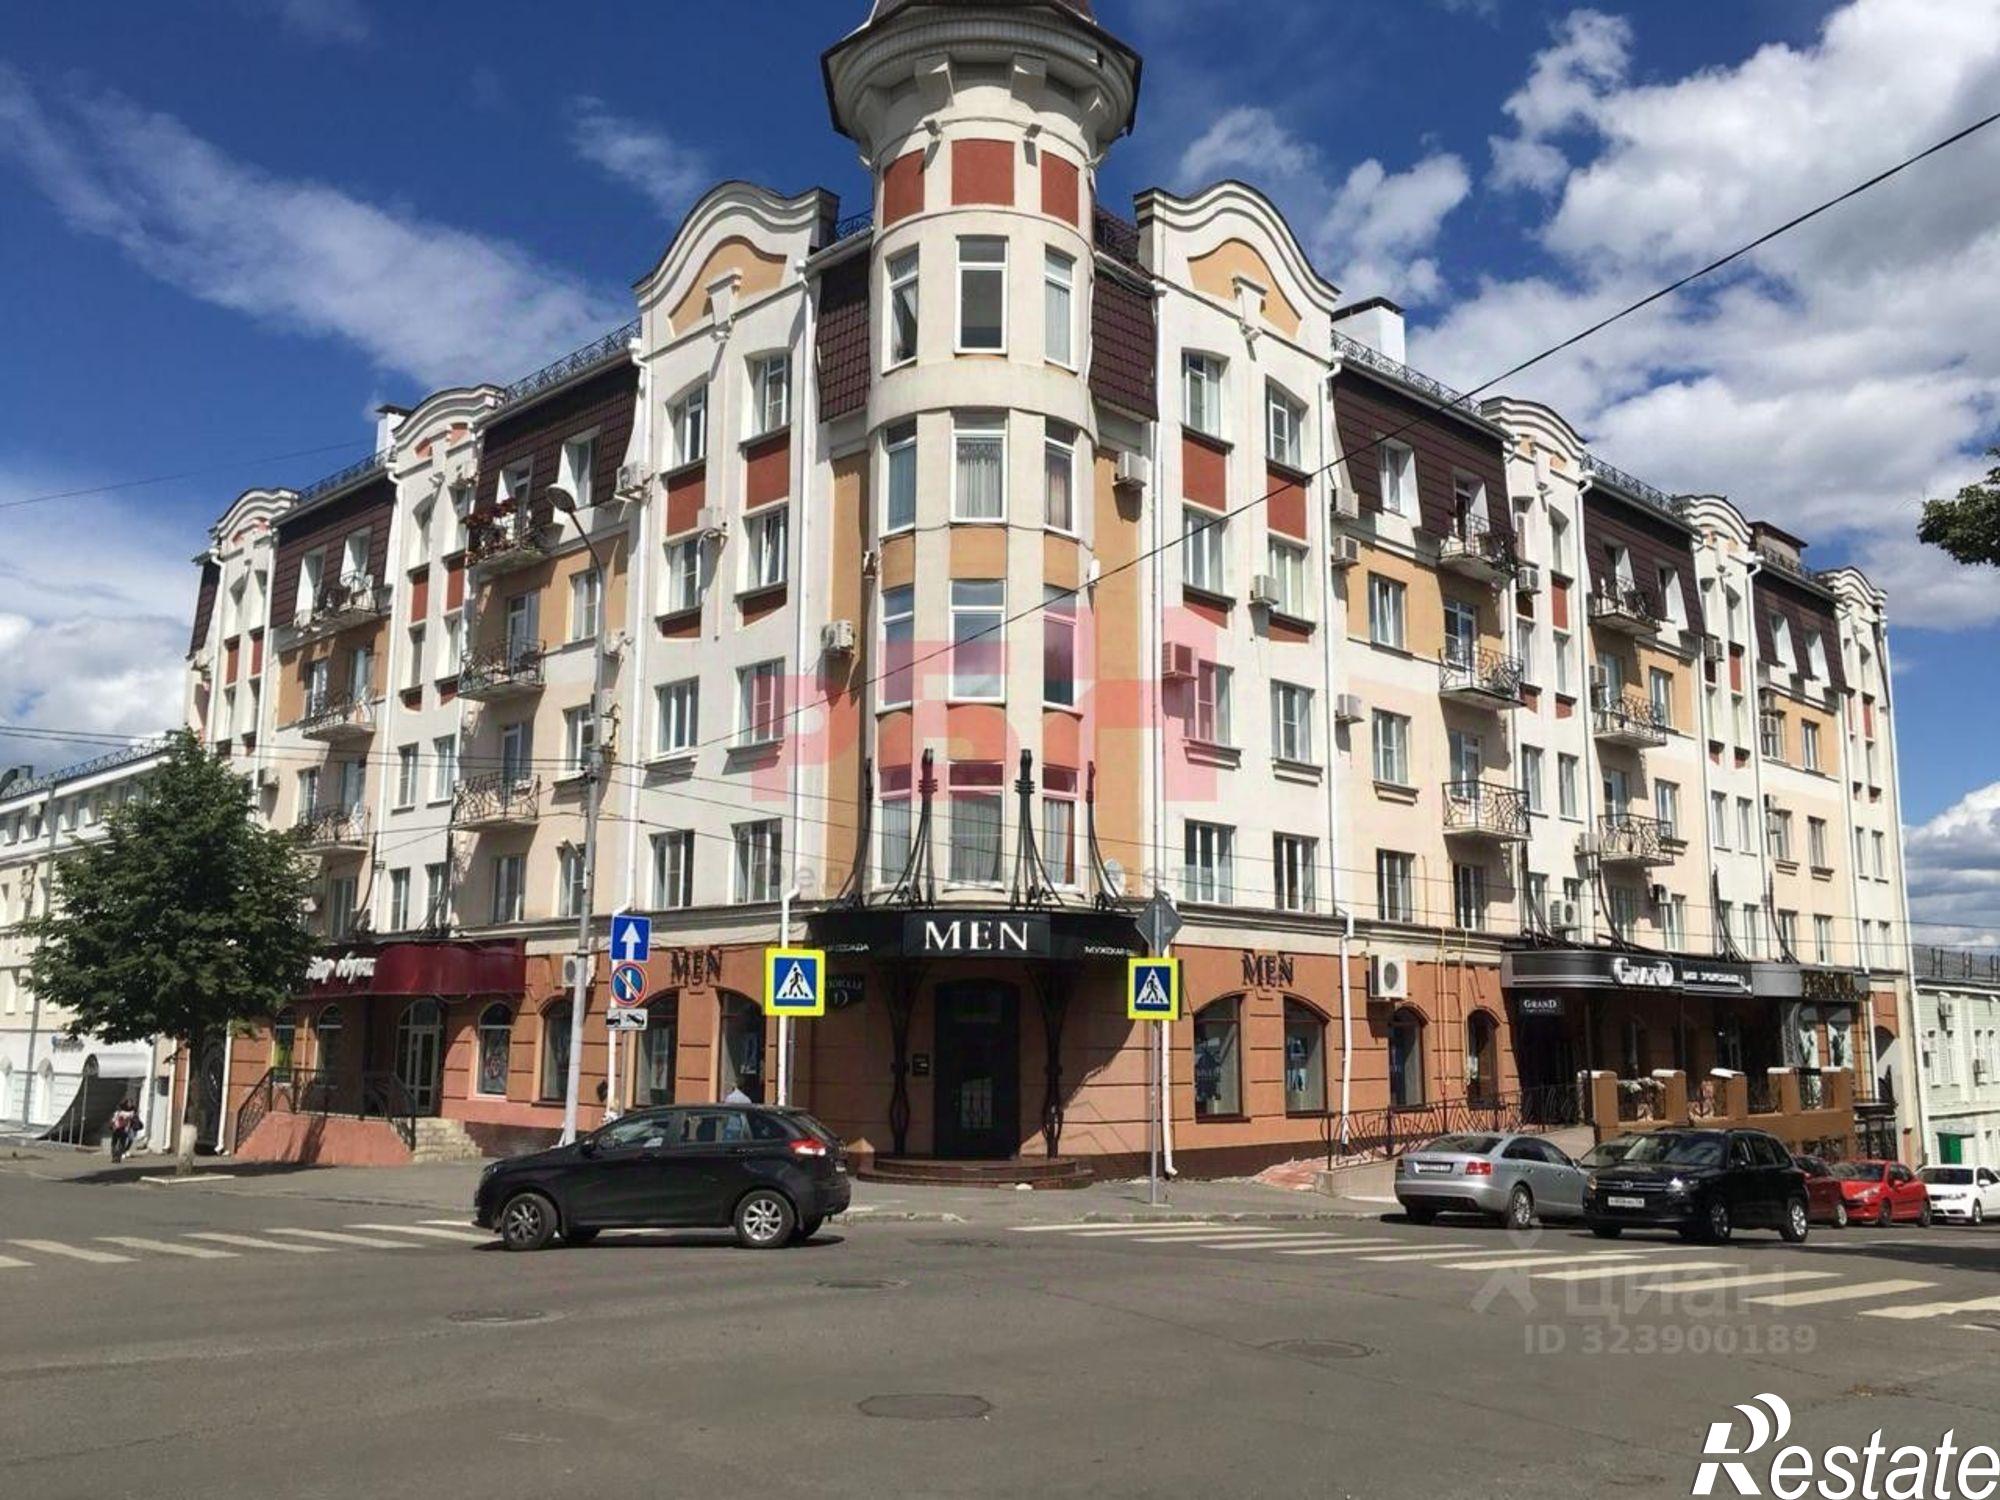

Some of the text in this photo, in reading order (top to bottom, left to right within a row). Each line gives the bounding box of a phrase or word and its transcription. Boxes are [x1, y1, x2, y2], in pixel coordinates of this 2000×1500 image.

[925, 921, 1028, 951] MEN
[671, 949, 722, 985] MEN
[1242, 954, 1294, 988] MEN
[1523, 999, 1557, 1009] GRAND
